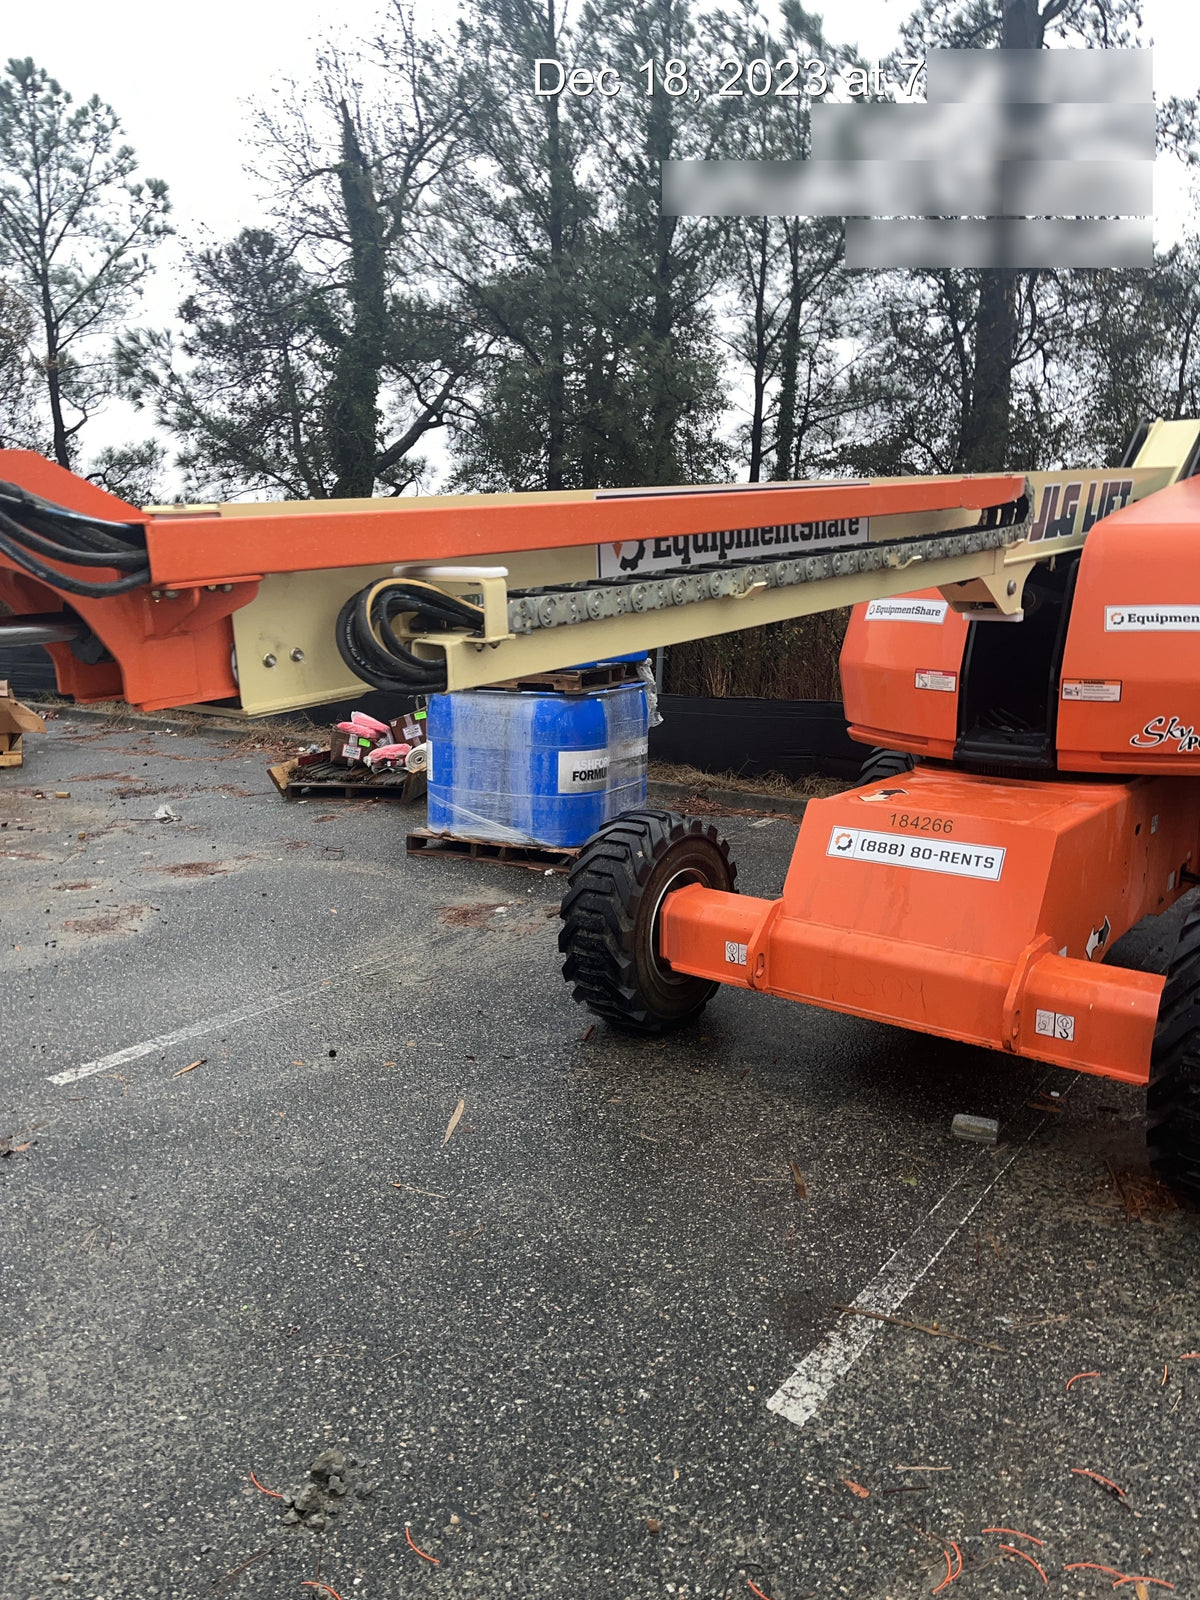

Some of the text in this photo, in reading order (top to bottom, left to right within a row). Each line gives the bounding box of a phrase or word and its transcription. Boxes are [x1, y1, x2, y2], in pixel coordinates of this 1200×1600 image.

[1028, 481, 1083, 544] JLG
[875, 604, 942, 616] EquipmentShare
[890, 812, 954, 834] 184266
[860, 838, 995, 869] (888) 80-RENTS
